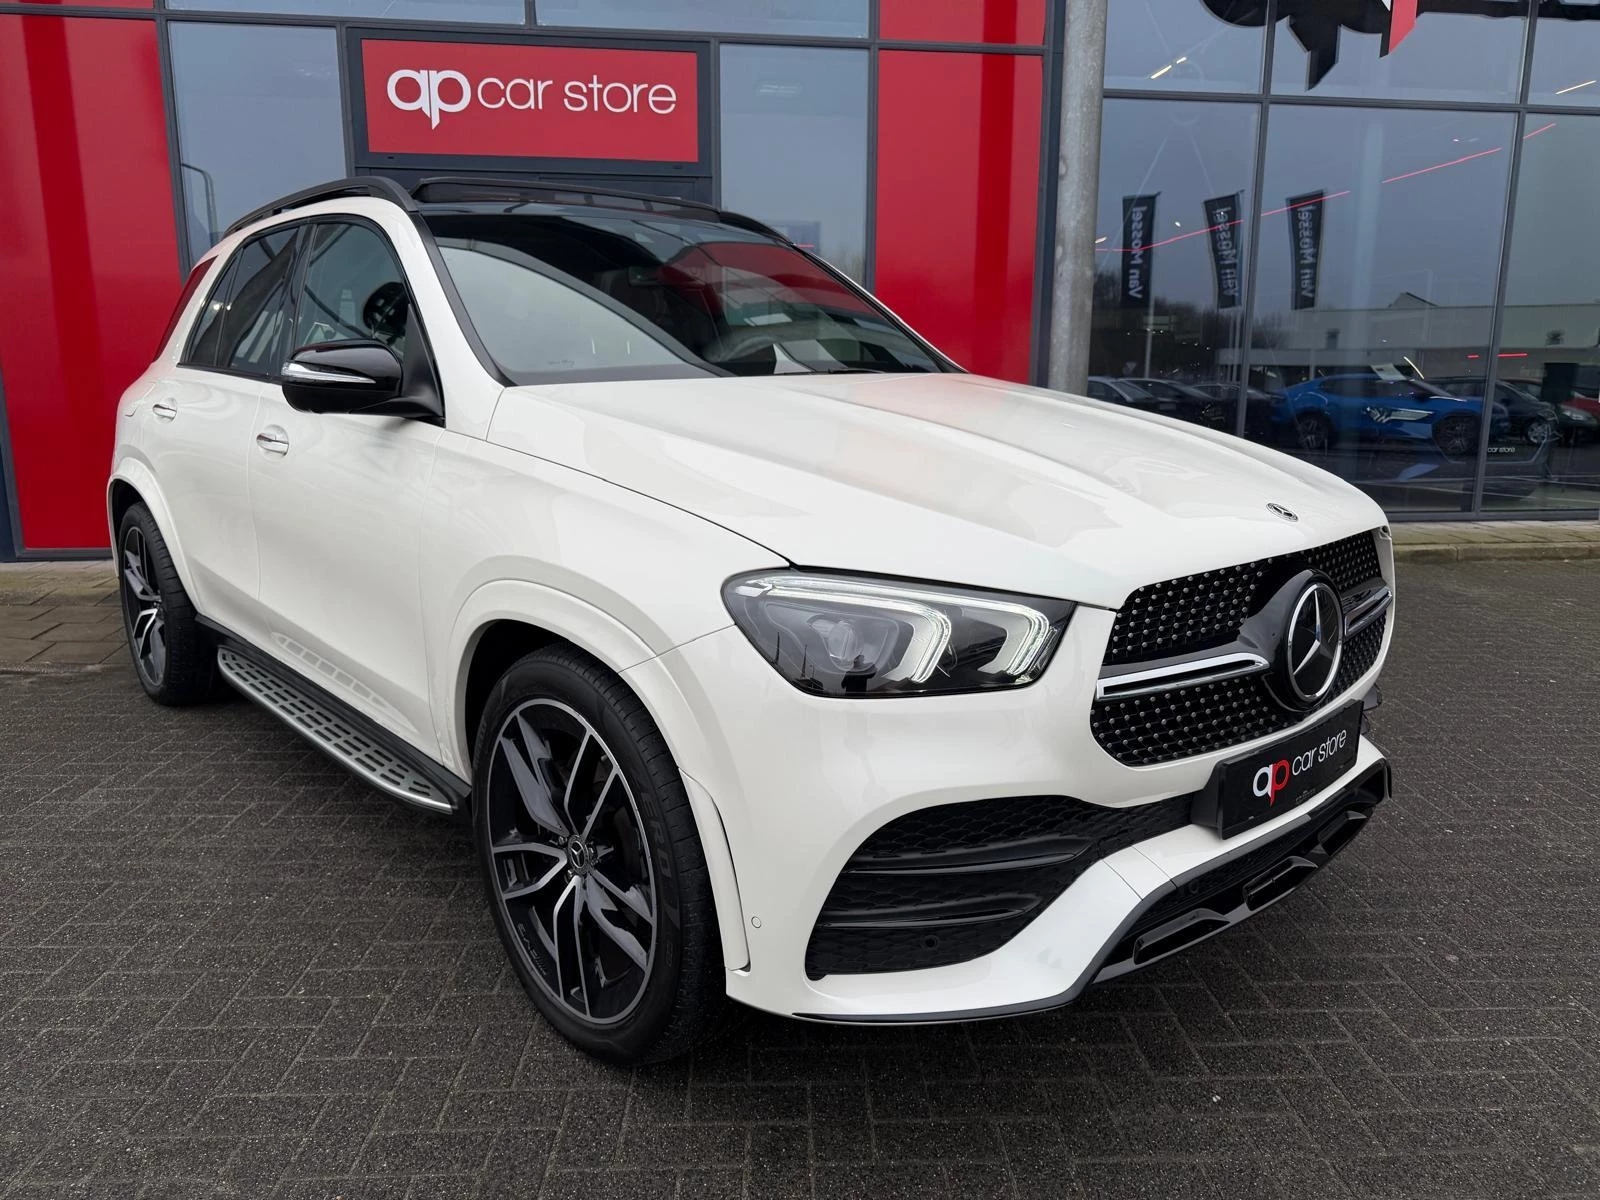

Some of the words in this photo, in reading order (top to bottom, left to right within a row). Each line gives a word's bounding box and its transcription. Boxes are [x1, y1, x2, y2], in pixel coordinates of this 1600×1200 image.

[477, 77, 553, 110] car
[563, 74, 677, 114] store
[1292, 747, 1317, 776] car
[1318, 729, 1347, 762] store
